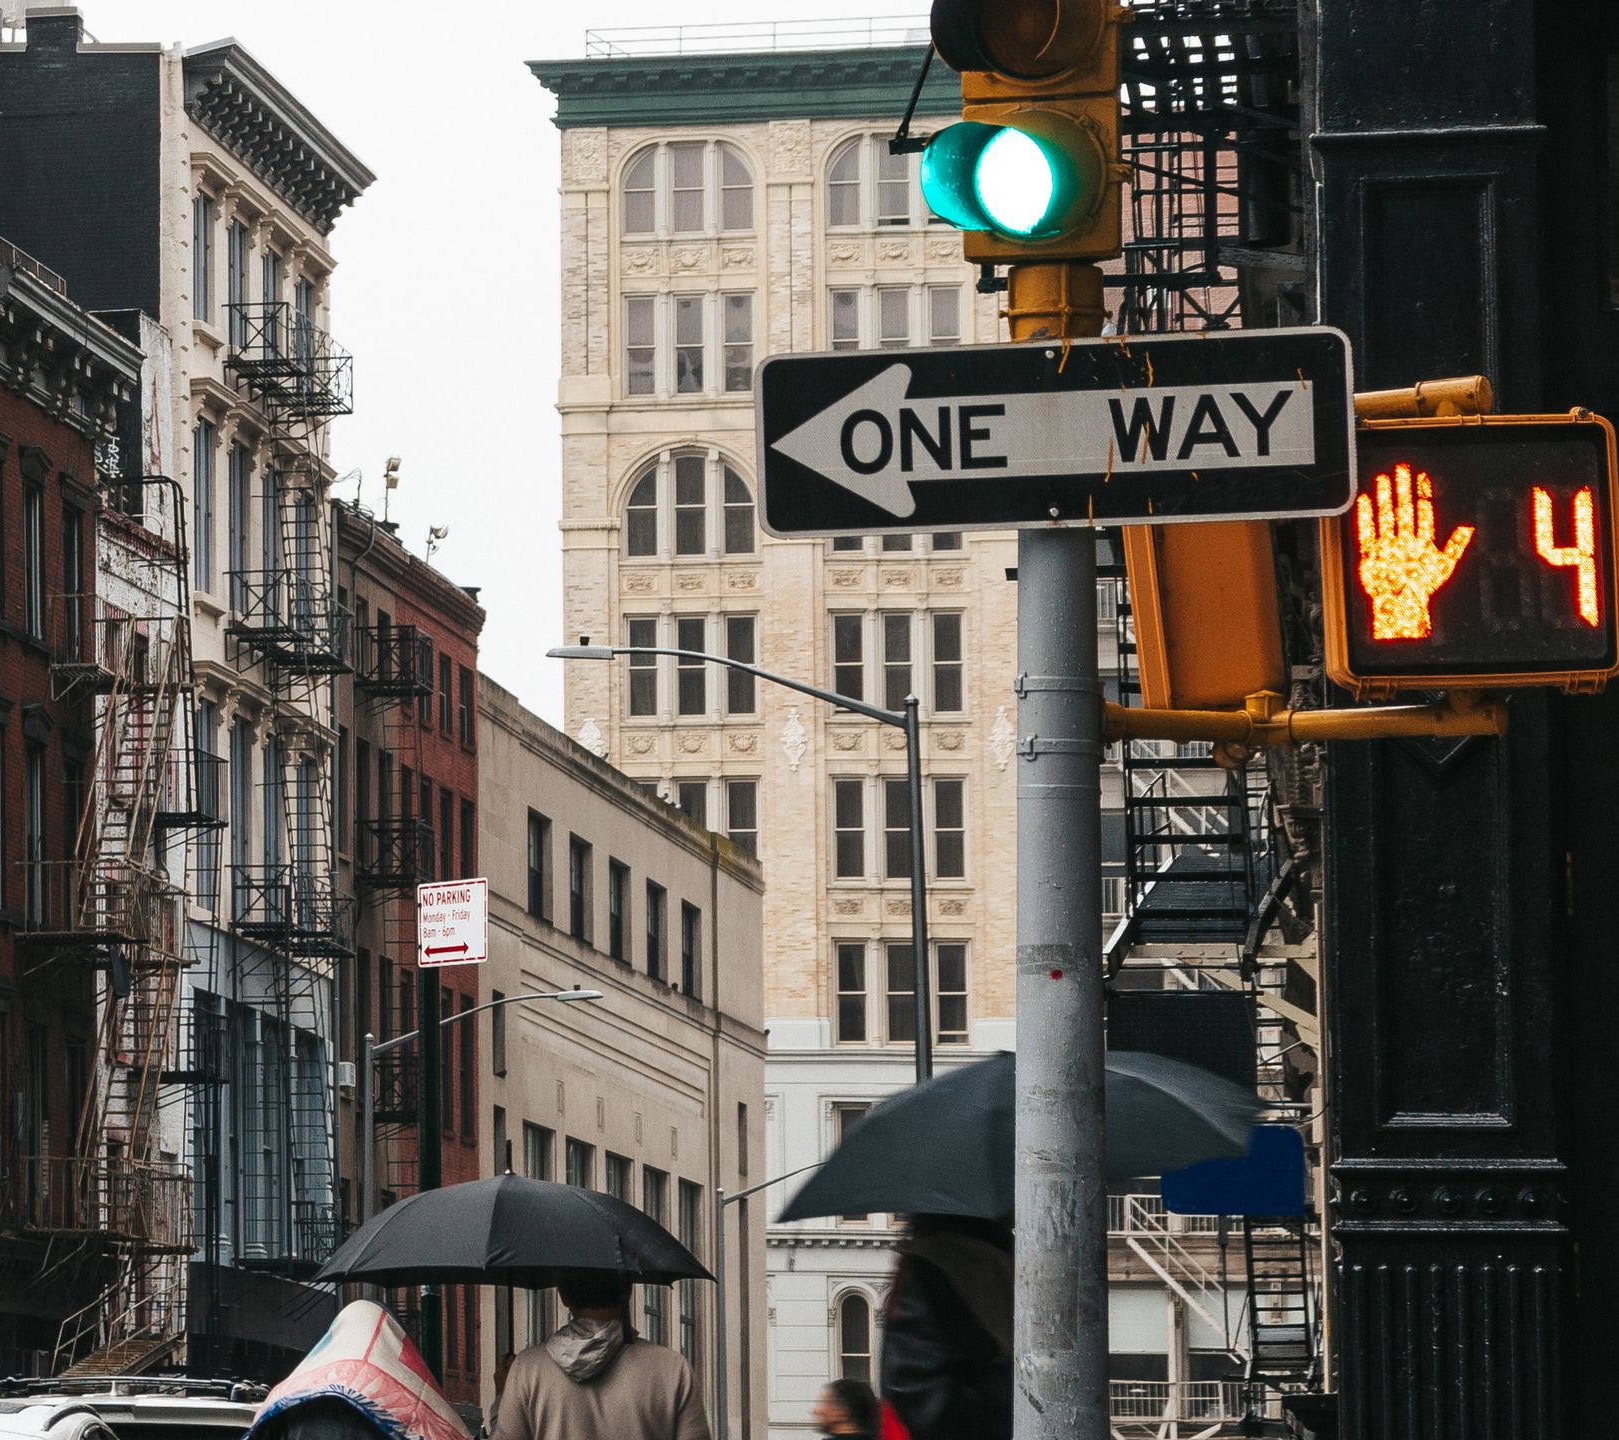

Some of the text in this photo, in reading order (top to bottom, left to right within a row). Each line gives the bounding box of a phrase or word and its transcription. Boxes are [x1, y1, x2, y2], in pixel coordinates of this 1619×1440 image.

[840, 389, 1295, 474] ONE WAY
[1533, 485, 1600, 629] 4
[422, 888, 471, 907] NO PARKING
[423, 911, 447, 923] Monday
[452, 908, 470, 922] Friday
[423, 927, 437, 938] 8am
[442, 926, 456, 938] 6pm
